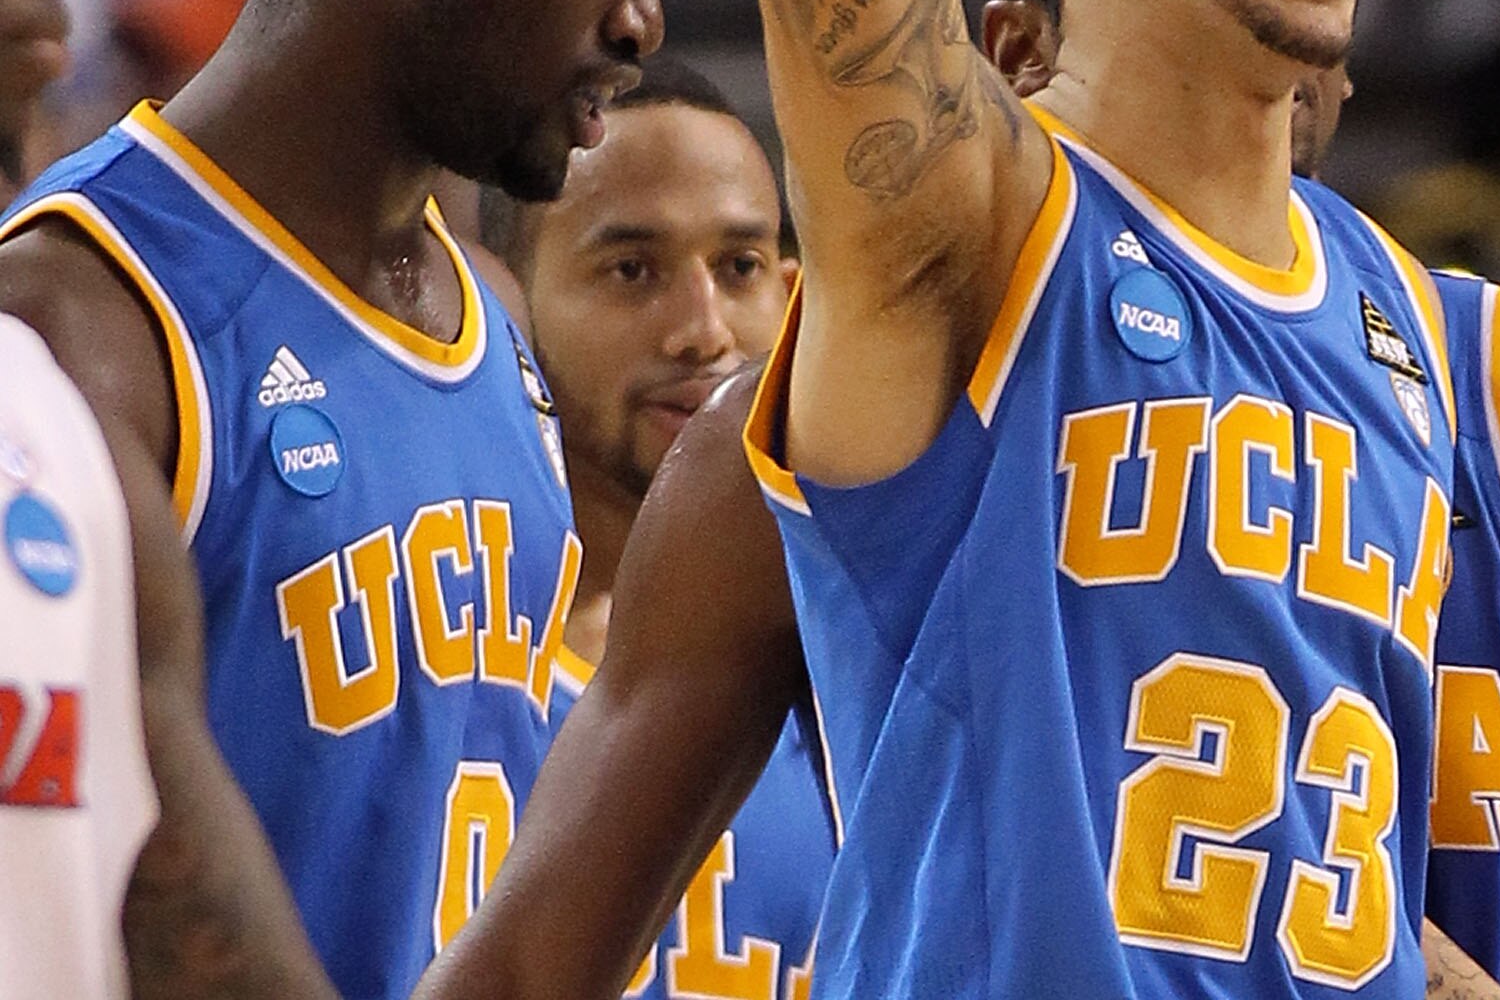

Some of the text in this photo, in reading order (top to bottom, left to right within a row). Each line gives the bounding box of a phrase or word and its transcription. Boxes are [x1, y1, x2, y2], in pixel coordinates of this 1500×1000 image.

[1119, 302, 1180, 341] NCAA
[258, 376, 328, 408] adidas
[281, 442, 341, 474] NCAA
[1108, 651, 1397, 991] 23
[432, 760, 516, 955] 0
